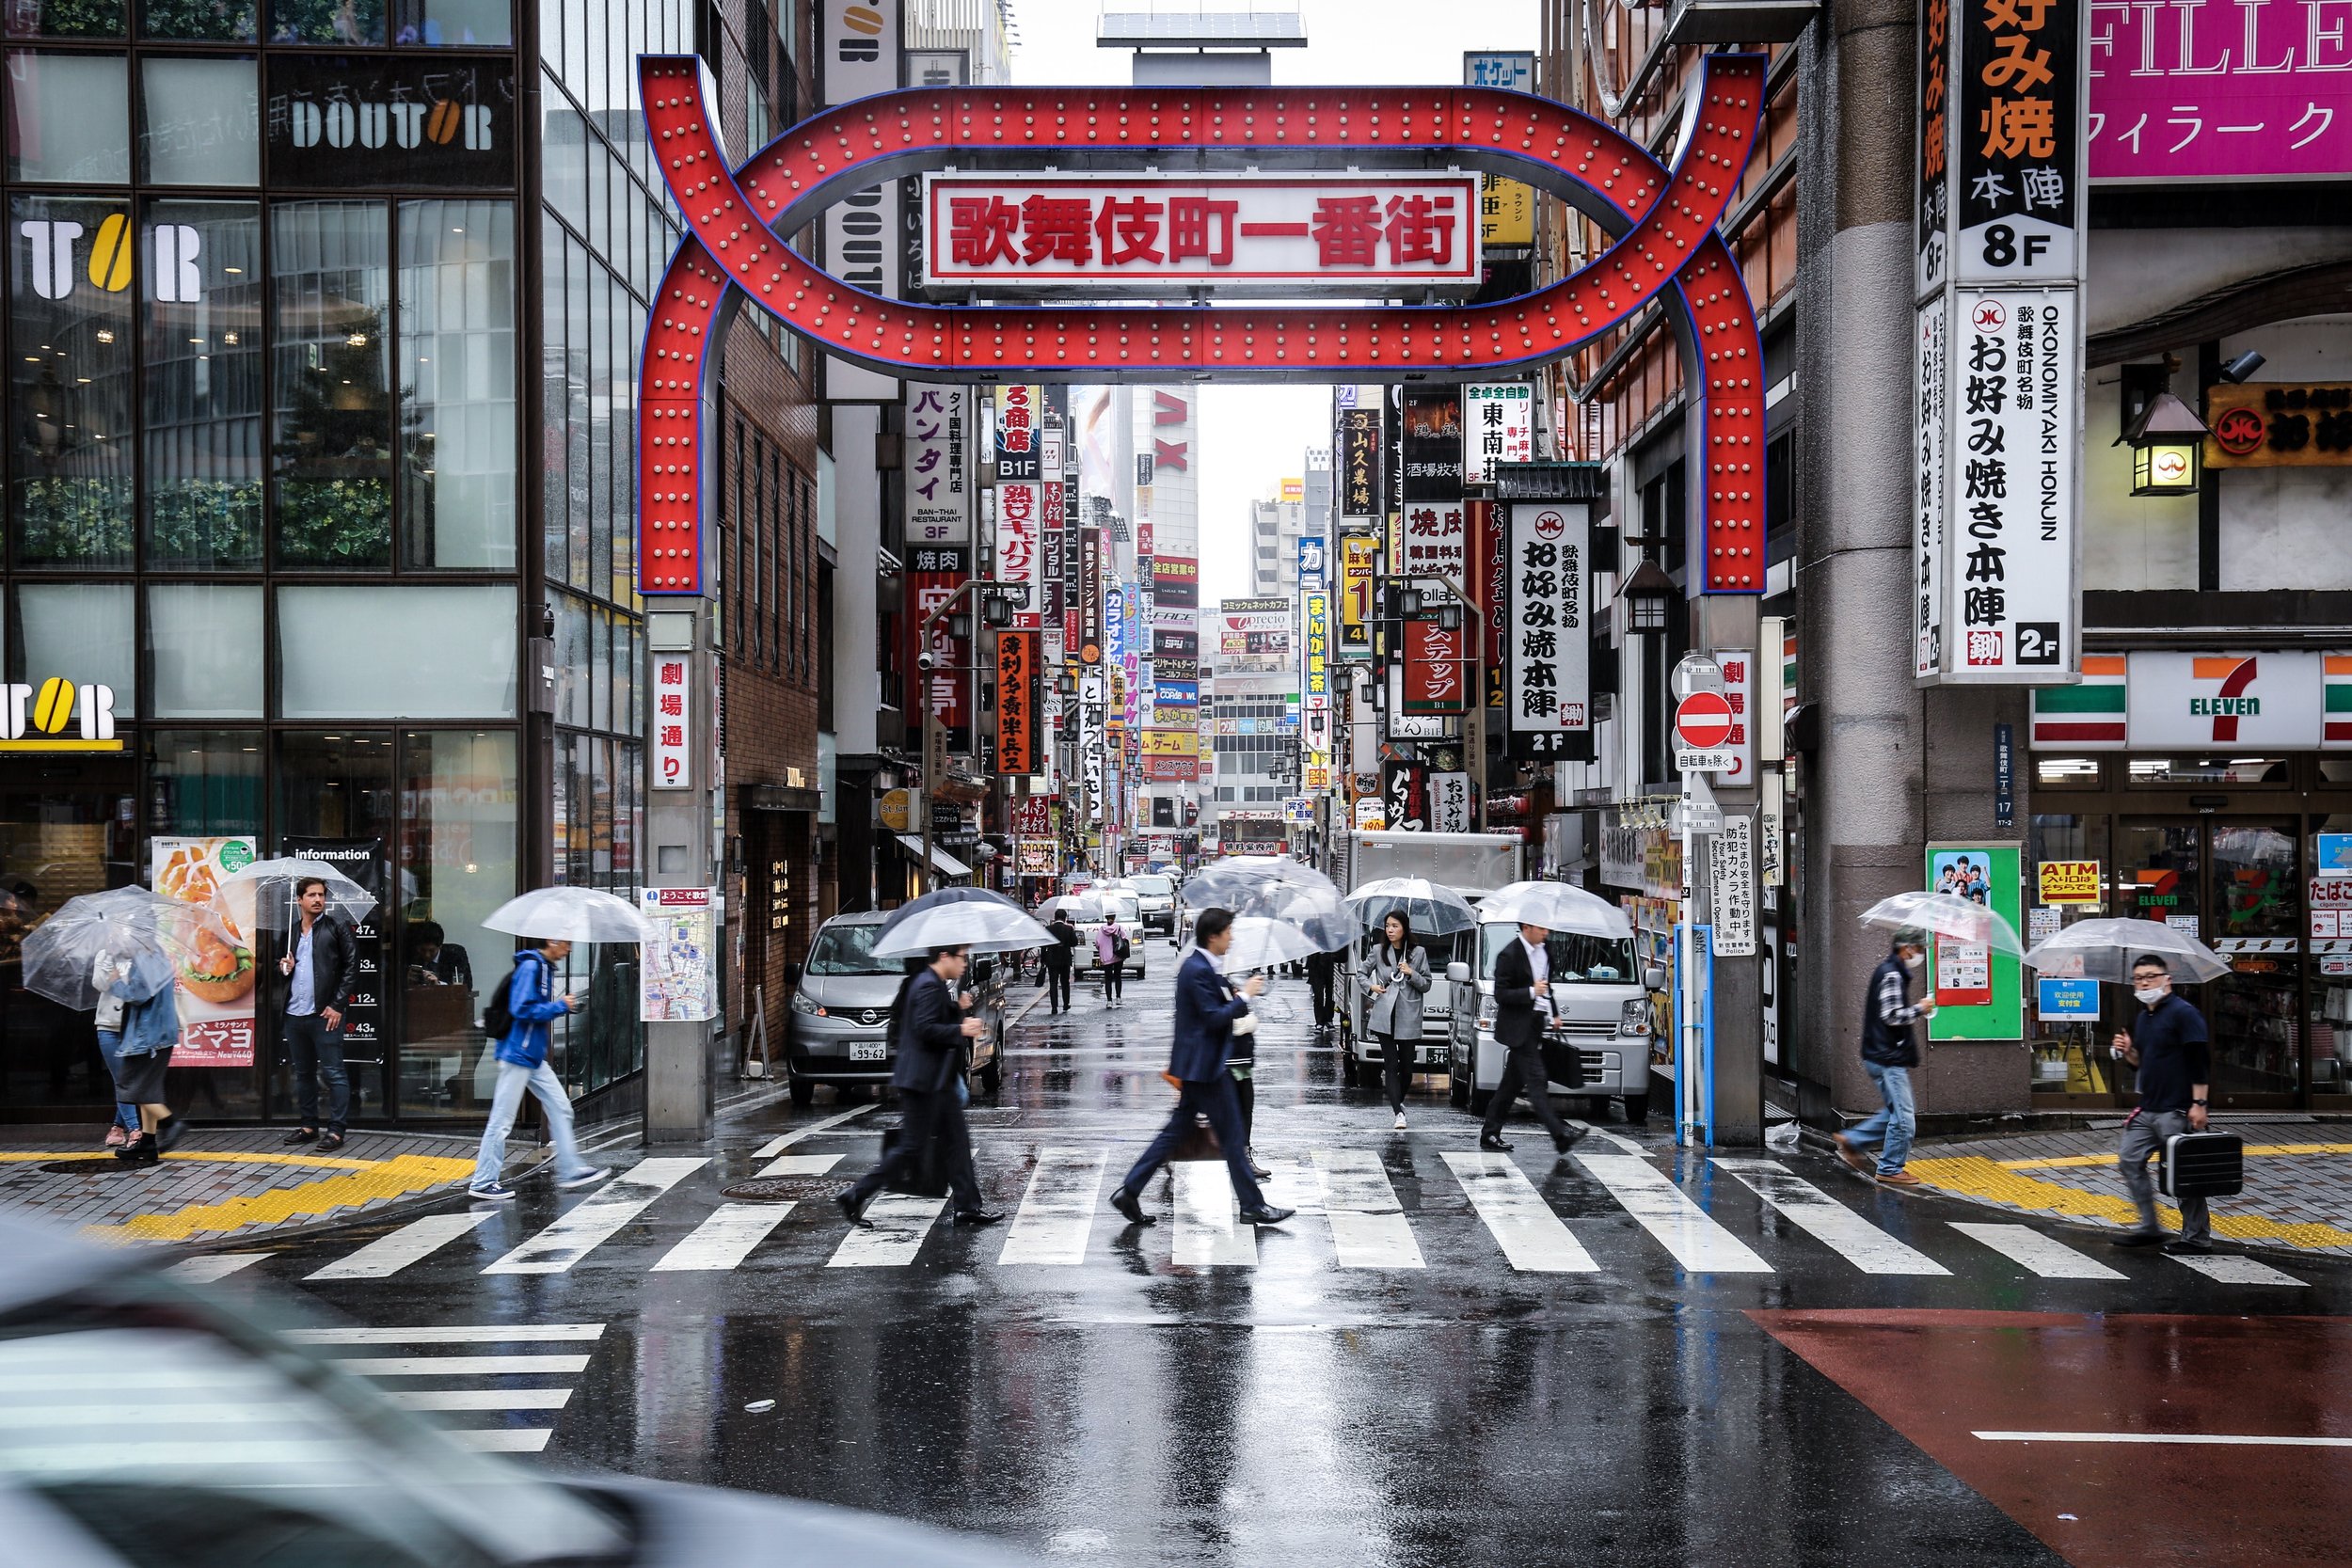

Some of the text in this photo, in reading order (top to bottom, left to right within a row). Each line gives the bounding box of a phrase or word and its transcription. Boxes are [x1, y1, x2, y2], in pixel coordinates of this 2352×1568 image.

[1474, 58, 1527, 86] ポケット
[292, 99, 492, 150] DOUTOR
[1971, 165, 2063, 211] 本陣
[950, 195, 1455, 266] 歌舞伎町一番街
[1983, 224, 2050, 267] 8F
[1927, 242, 1942, 281] 8F
[2017, 306, 2034, 410] 歌舞伎町名物
[1469, 387, 1529, 399] 全卓全自動
[1519, 403, 1530, 462] リーチ麻雀
[2041, 306, 2058, 541] OKONOMIYAKI HONJIN
[912, 390, 944, 500] バンタイ
[949, 392, 962, 493] タイ国料理専門店
[1483, 403, 1502, 482] 東南荘
[1507, 427, 1518, 456] 専門
[1000, 460, 1036, 476] B1F
[1469, 473, 1479, 482] 3F
[1964, 334, 2008, 627] お好み焼き本陣
[1920, 351, 1931, 632] お好み焼き本陣
[925, 527, 948, 538] 3F
[916, 551, 958, 570] 焼肉
[1048, 533, 1058, 577] レンタル
[1153, 562, 1196, 576] 全店営業中
[1085, 542, 1095, 637] 個室ダイニング居酒屋
[1561, 545, 1579, 628] 歌舞伎町名物
[1106, 594, 1122, 651] カラオケ
[1141, 626, 1150, 651] SEGA
[1522, 542, 1558, 718] お好み焼本陣
[1310, 598, 1325, 692] まんが喫茶
[2020, 629, 2057, 657] 2F
[1141, 664, 1150, 689] SEGA
[1423, 624, 1454, 699] ステップ
[1113, 677, 1122, 706] 麻雀
[1124, 653, 1138, 724] カラオケ
[660, 662, 683, 777] 劇場通り
[1258, 720, 1273, 733] 釣具
[1153, 738, 1181, 751] ゲーム
[1468, 722, 1476, 768] 劇場通り一番街
[1533, 733, 1564, 751] 2F
[1155, 760, 1194, 770] メンズサウナ
[1680, 755, 1729, 768] 自転車を除く
[1229, 811, 1257, 819] コーヒー
[1997, 802, 2011, 813] 17
[295, 848, 370, 861] information
[1711, 840, 1720, 867] Security
[2042, 863, 2097, 876] ATM
[1725, 828, 1741, 932] 防犯カメラ作動中
[1739, 822, 1752, 938] みなさまの安全を守ります
[2042, 883, 2097, 892] そちらです
[2311, 880, 2352, 901] たばこ
[857, 1049, 884, 1059] 99-62
